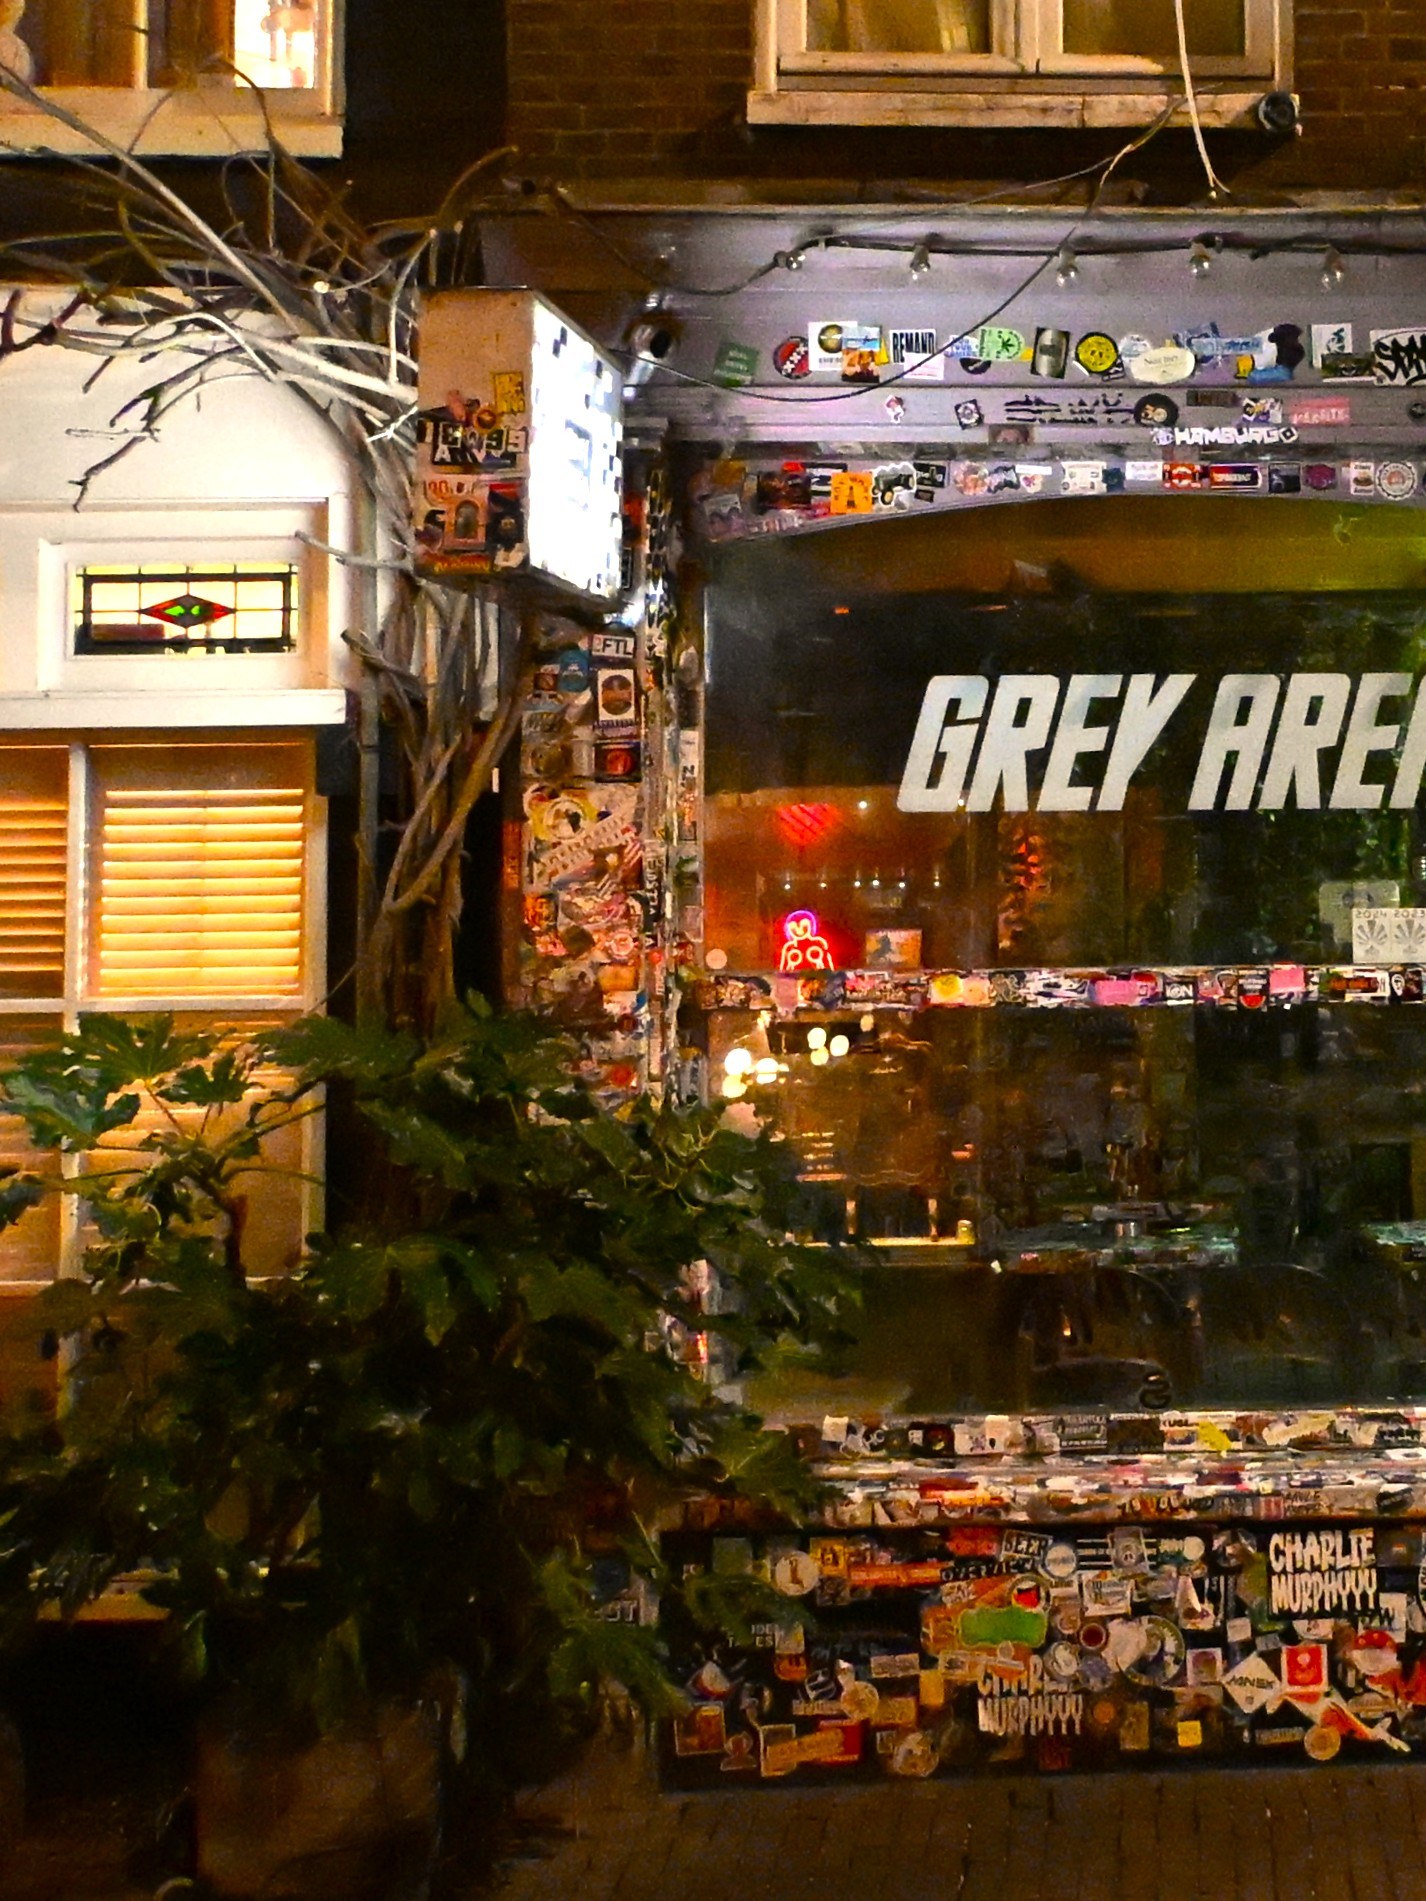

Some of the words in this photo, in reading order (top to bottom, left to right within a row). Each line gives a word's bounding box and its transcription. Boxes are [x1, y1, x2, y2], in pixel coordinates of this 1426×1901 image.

[897, 673, 1198, 813] GREY
[1355, 910, 1387, 919] 2024
[1393, 910, 1426, 919] 2023
[1269, 1527, 1376, 1573] CHARLIE
[1271, 1567, 1378, 1615] MURPHYYY
